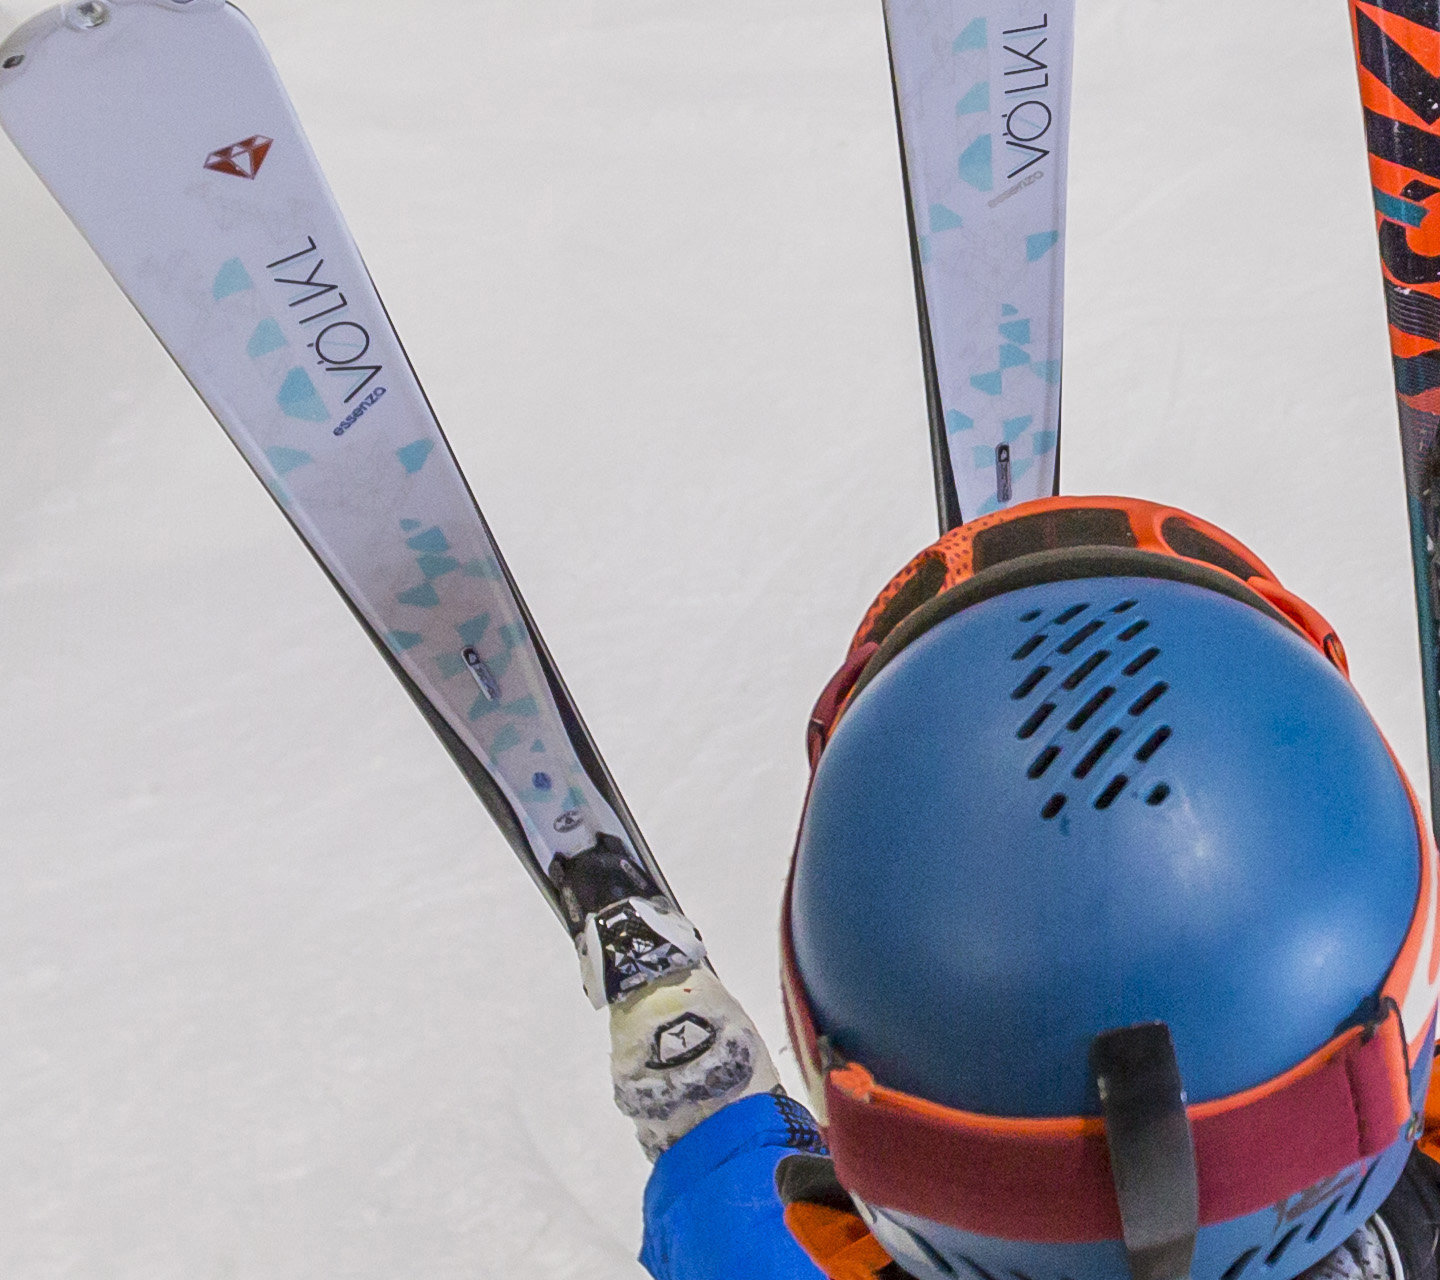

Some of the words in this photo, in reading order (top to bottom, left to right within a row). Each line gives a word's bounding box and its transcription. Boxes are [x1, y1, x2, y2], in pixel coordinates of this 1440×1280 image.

[1001, 13, 1052, 179] VÖLKL
[266, 235, 383, 403] VÖLKL
[332, 386, 387, 437] essenza
